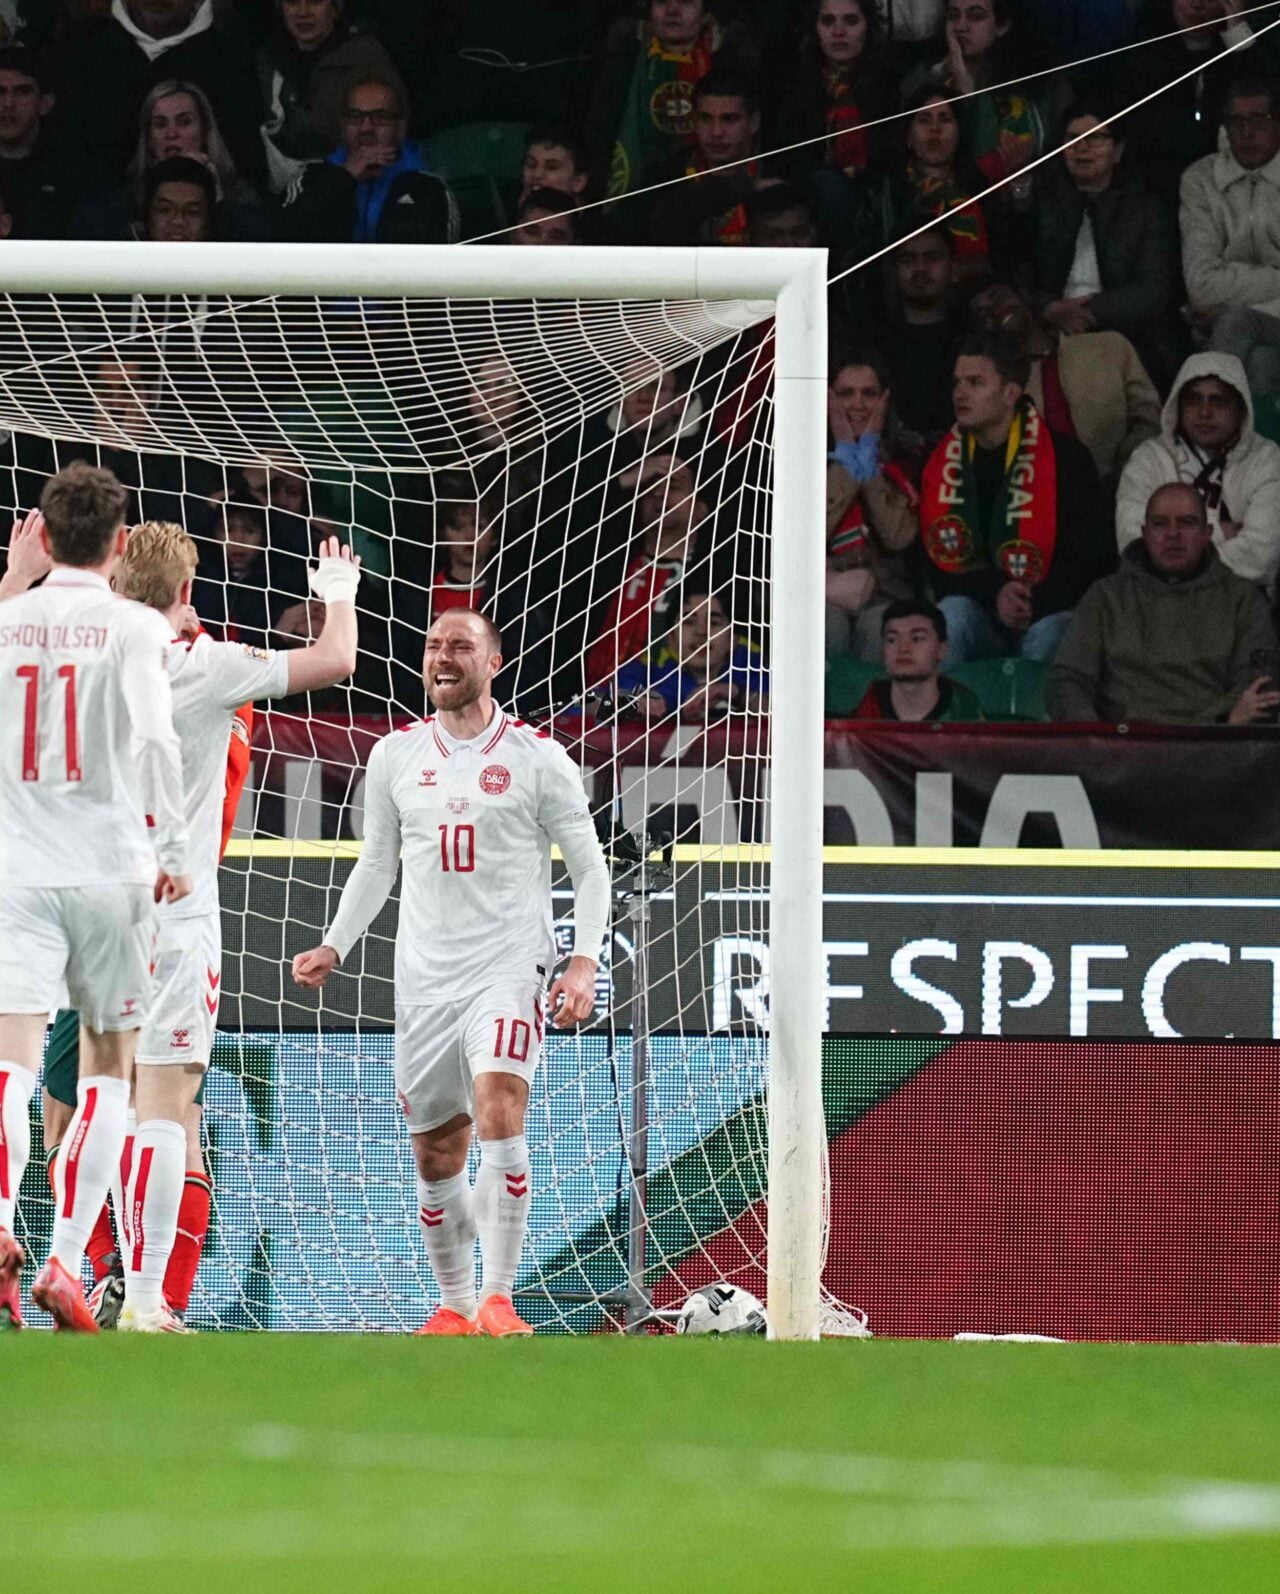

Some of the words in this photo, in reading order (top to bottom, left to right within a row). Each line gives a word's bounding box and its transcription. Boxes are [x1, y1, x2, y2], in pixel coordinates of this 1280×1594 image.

[938, 424, 965, 505] FOR
[16, 665, 82, 781] 11
[438, 824, 474, 872] 10
[493, 1018, 530, 1062] 10
